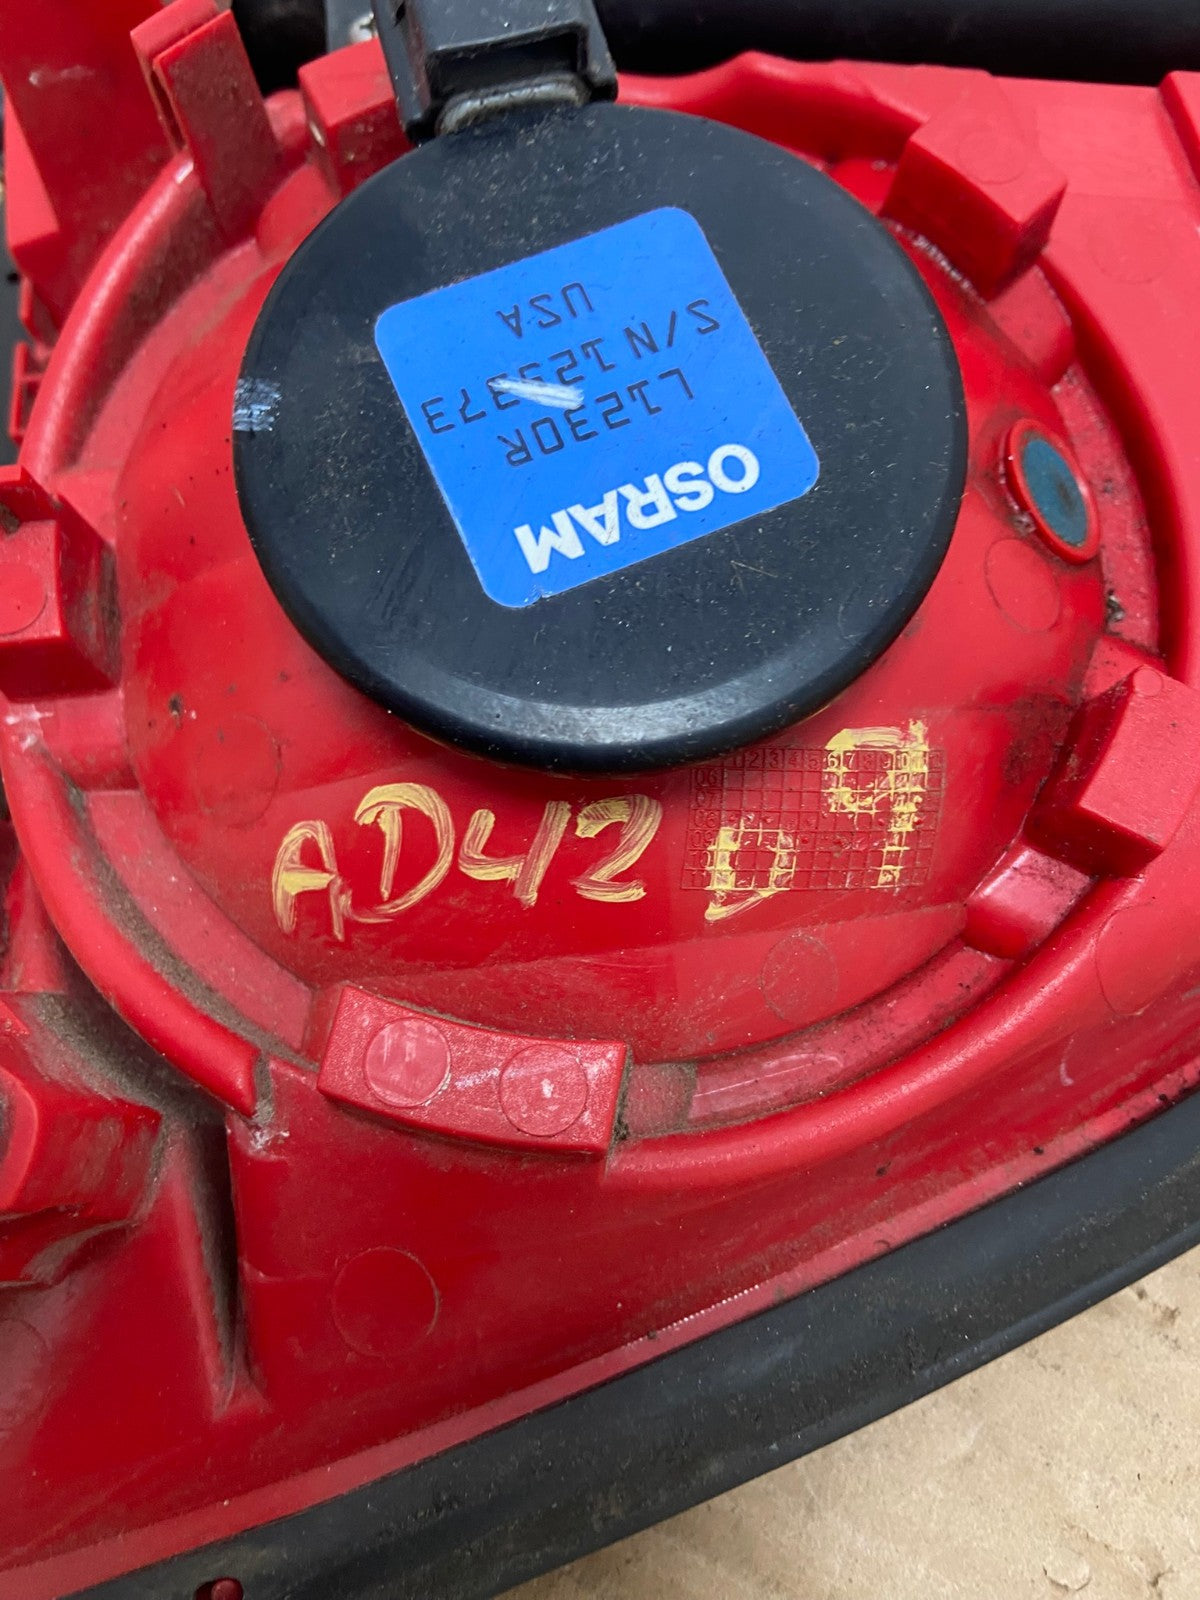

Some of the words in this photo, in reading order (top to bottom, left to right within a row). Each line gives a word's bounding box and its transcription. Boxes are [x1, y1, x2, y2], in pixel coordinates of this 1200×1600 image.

[496, 282, 594, 339] USA
[624, 298, 721, 359] S/N
[496, 367, 696, 467] L1230R
[514, 443, 761, 575] OSRAM
